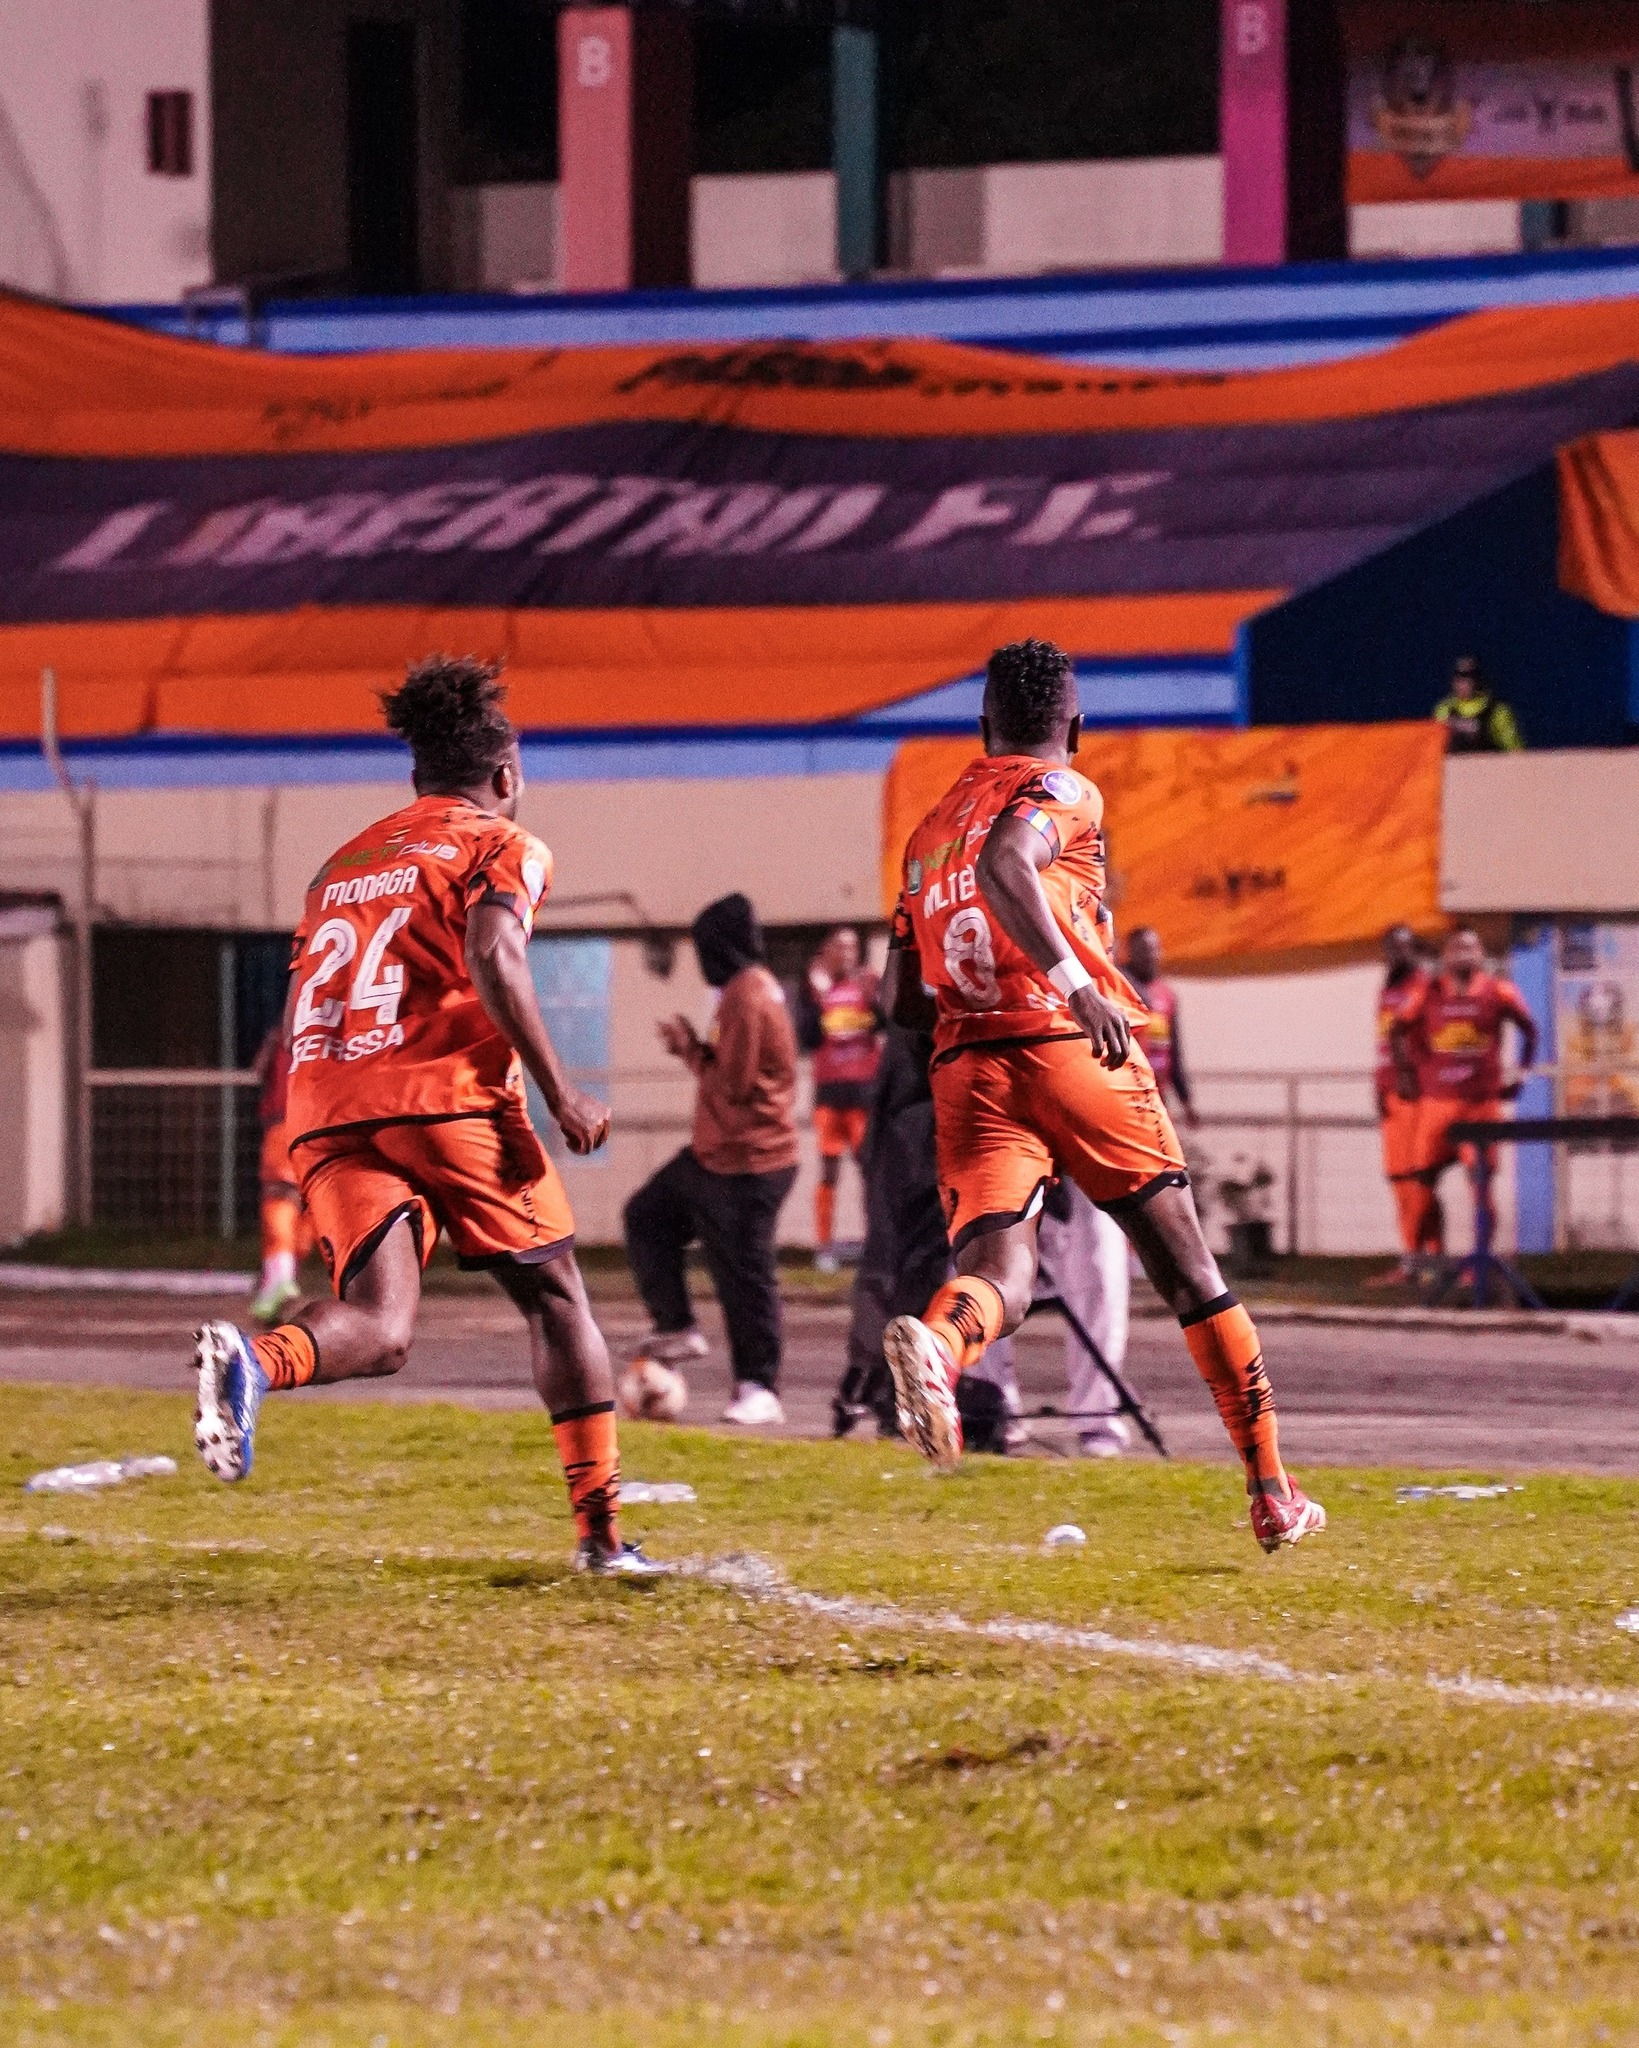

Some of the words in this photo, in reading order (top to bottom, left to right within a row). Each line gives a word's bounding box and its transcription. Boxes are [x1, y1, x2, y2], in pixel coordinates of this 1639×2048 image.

[577, 36, 610, 87] B
[1236, 3, 1267, 54] B
[292, 907, 413, 1037] 24
[943, 906, 1002, 1009] 8
